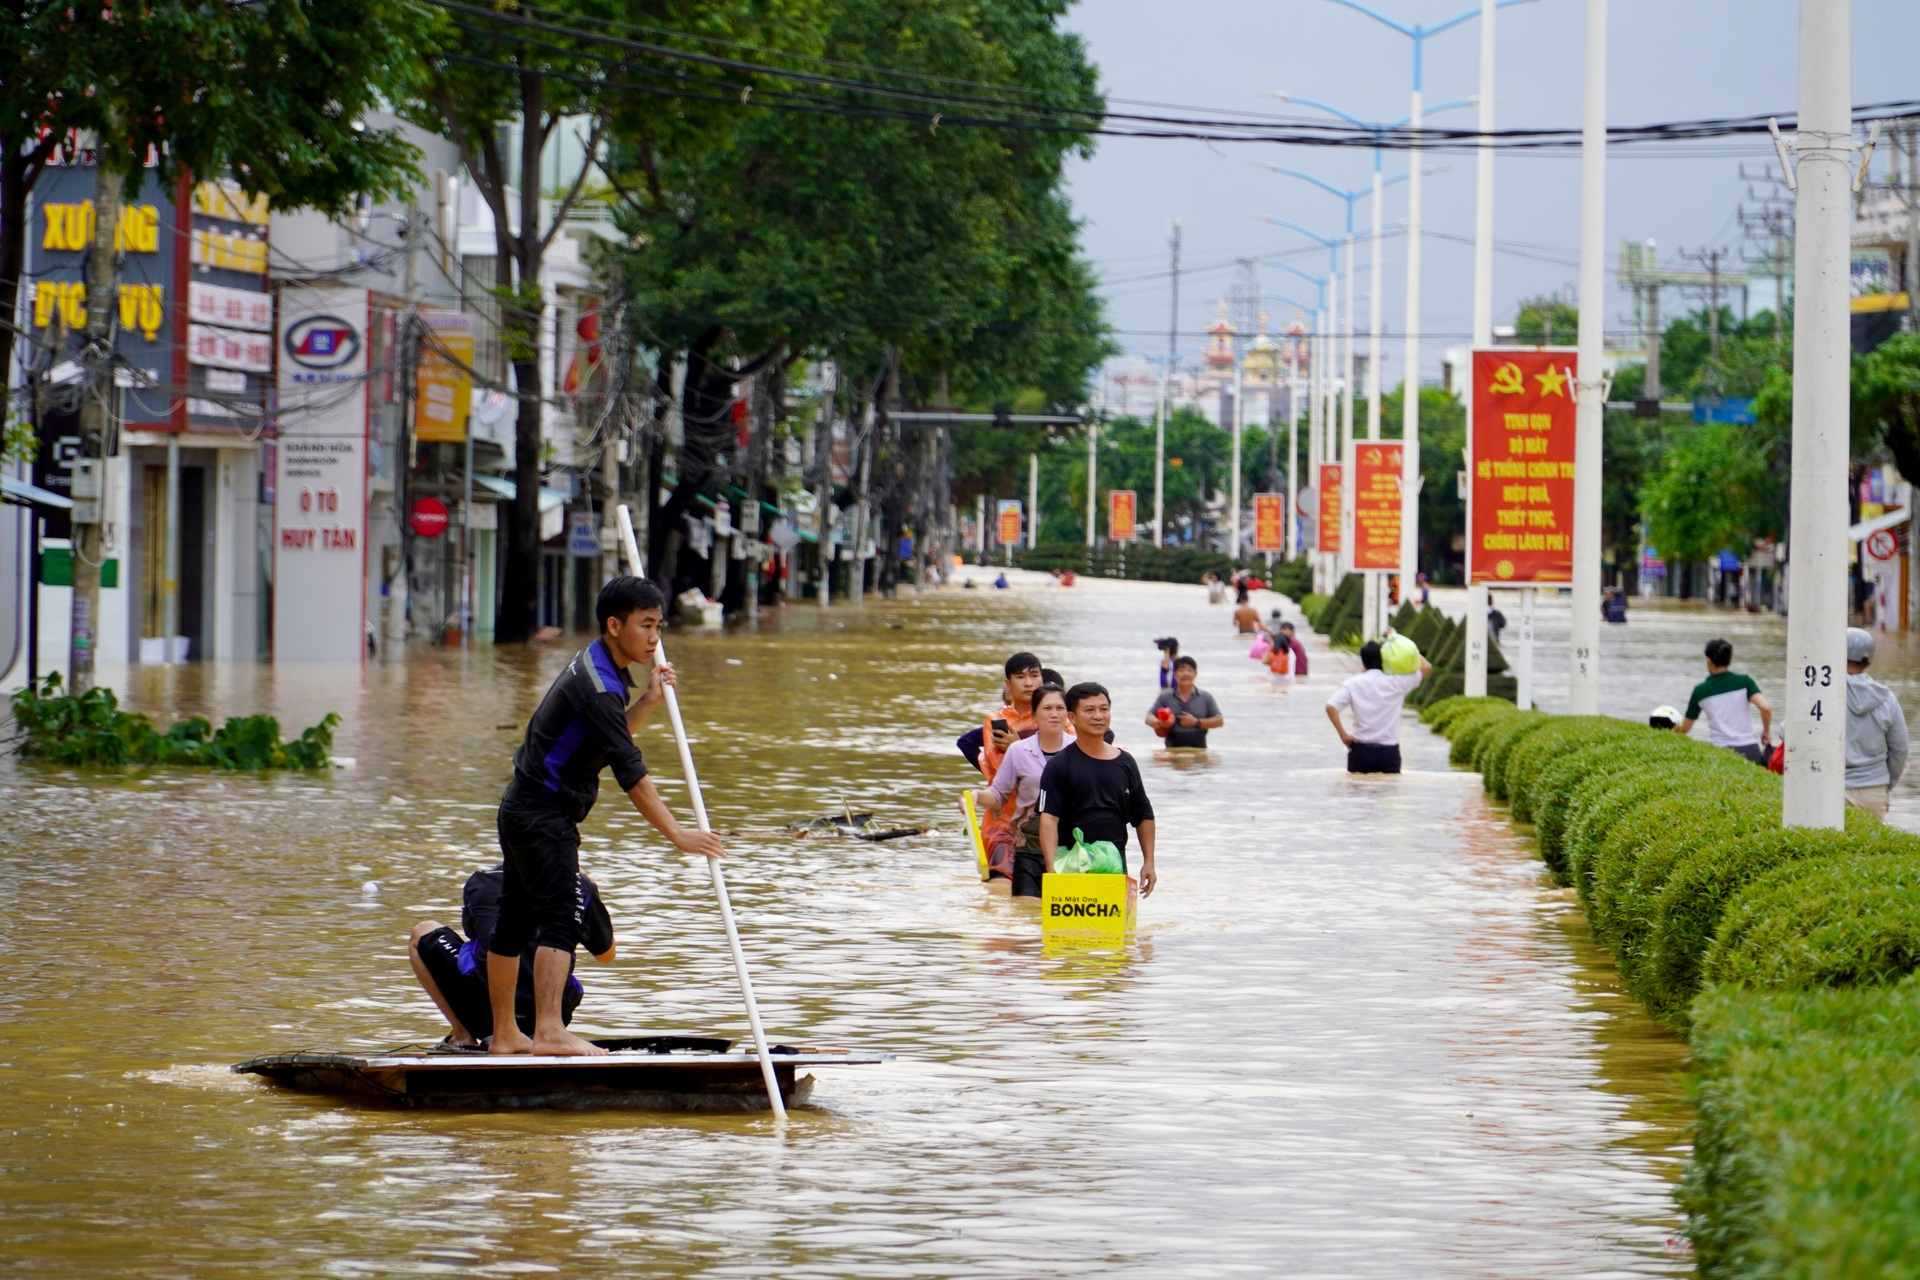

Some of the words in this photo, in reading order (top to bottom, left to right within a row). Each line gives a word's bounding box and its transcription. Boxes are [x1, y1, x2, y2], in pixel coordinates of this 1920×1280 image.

[42, 199, 160, 253] XƯNG
[34, 281, 88, 336] DỊC
[119, 283, 163, 342] VỤ
[1503, 413, 1529, 430] TINH
[1509, 435, 1524, 457] BỘ
[1525, 435, 1548, 454] MÁY
[1477, 458, 1492, 480] HỆ
[1492, 457, 1527, 478] THỐNG
[1527, 459, 1559, 478] CHÍNH
[45, 473, 72, 487] Gree
[317, 486, 338, 513] TÔ
[1503, 483, 1527, 503] HIỆU
[1497, 505, 1526, 526] THIẾT
[281, 527, 316, 549] HUY
[322, 523, 356, 549] TÂN
[1483, 529, 1517, 550] CHỐNG
[1545, 531, 1564, 551] PHÍ
[1804, 665, 1832, 687] 93
[1810, 699, 1823, 721] 4
[1050, 903, 1121, 917] BONCHA
